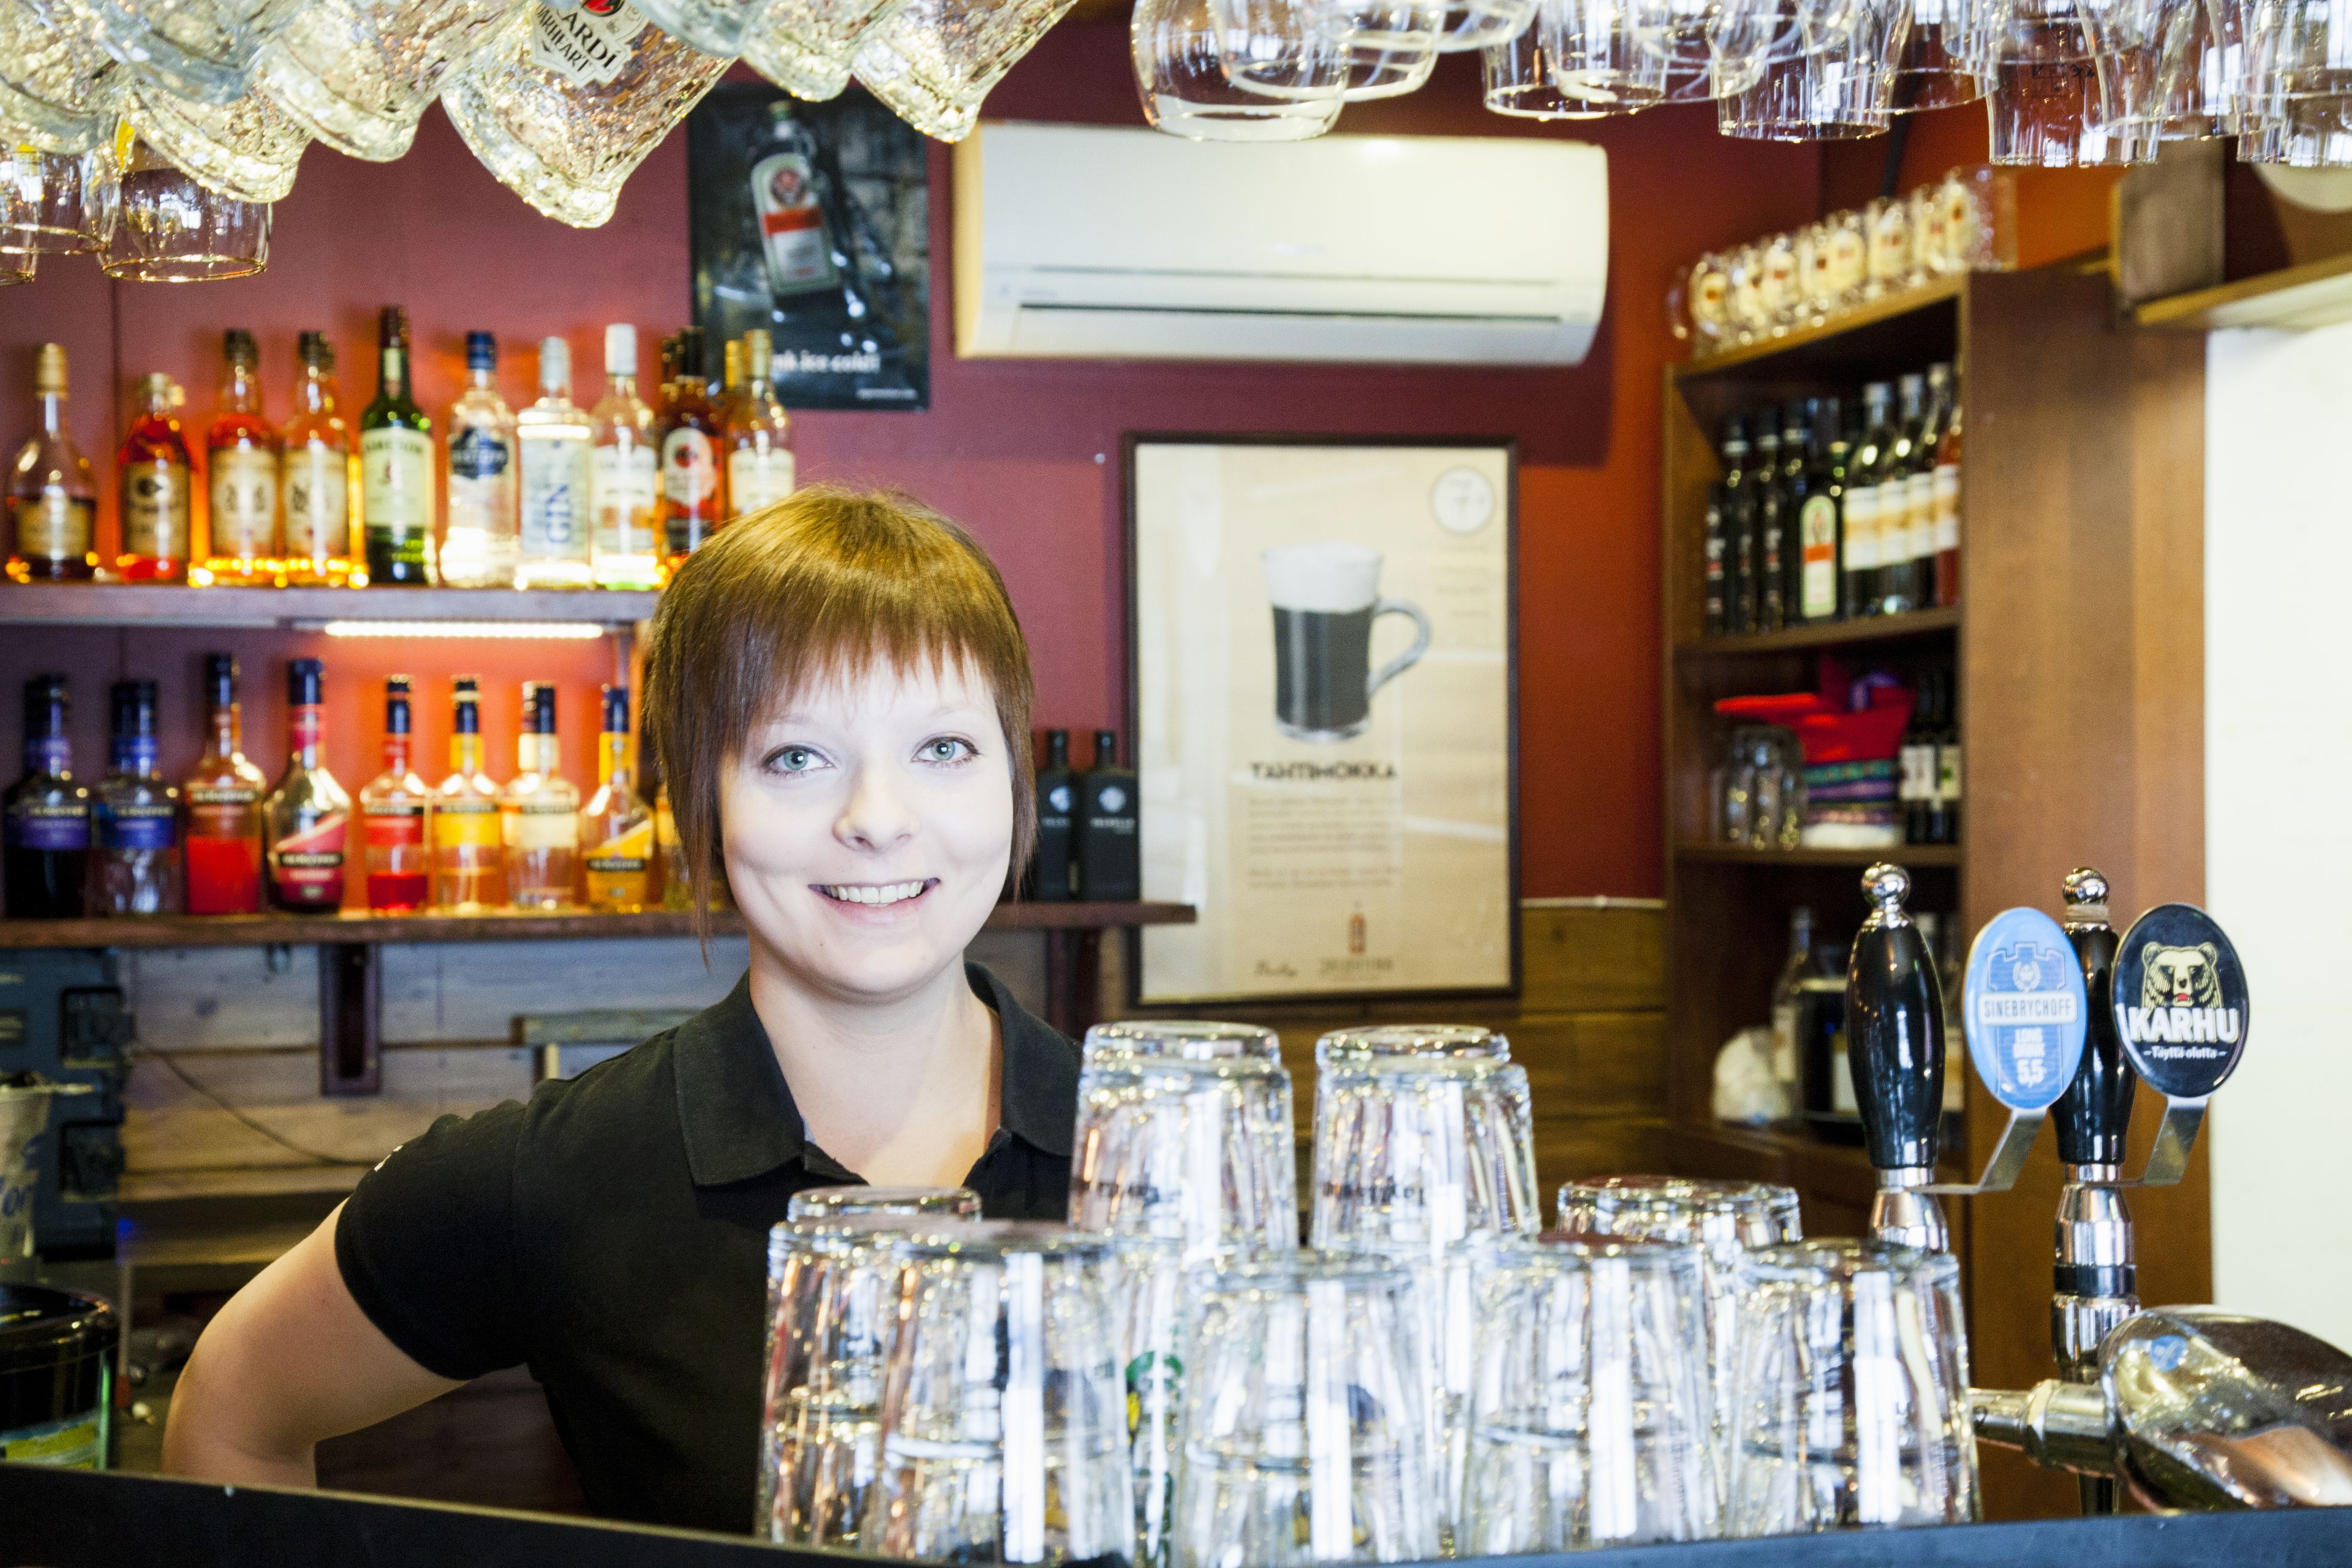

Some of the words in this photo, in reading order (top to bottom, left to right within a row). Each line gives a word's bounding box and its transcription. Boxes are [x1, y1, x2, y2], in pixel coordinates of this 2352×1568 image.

[1984, 998, 2071, 1018] SINEBRYCHOFF
[2127, 1006, 2239, 1044] KARHU
[2185, 1046, 2218, 1060] olutta
